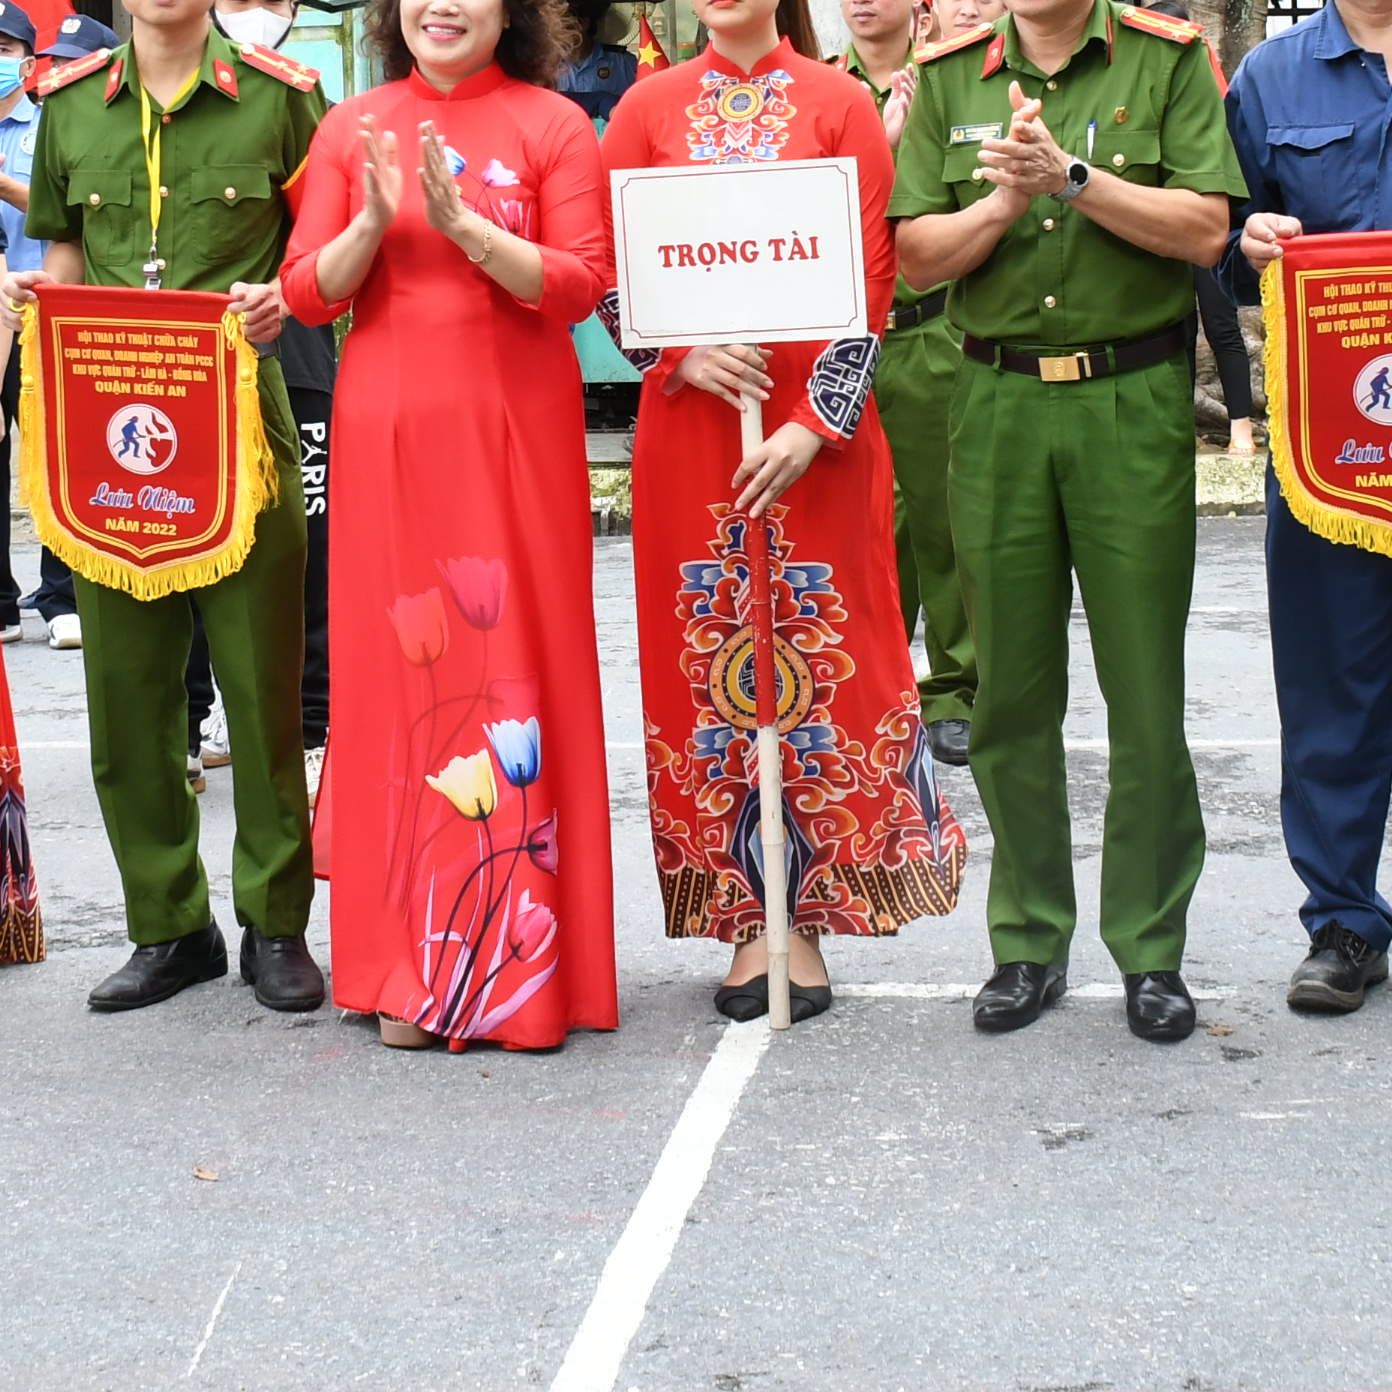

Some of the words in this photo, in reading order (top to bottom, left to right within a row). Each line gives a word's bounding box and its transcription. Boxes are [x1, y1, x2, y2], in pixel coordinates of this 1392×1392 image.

[658, 240, 759, 272] TRỌNG
[768, 231, 820, 261] TÀI
[1342, 331, 1379, 348] QUẬN
[96, 381, 130, 395] QUẬN
[168, 385, 186, 397] AN
[137, 485, 196, 519] Niệm
[106, 516, 140, 533] NĂM
[143, 522, 177, 536] 2022
